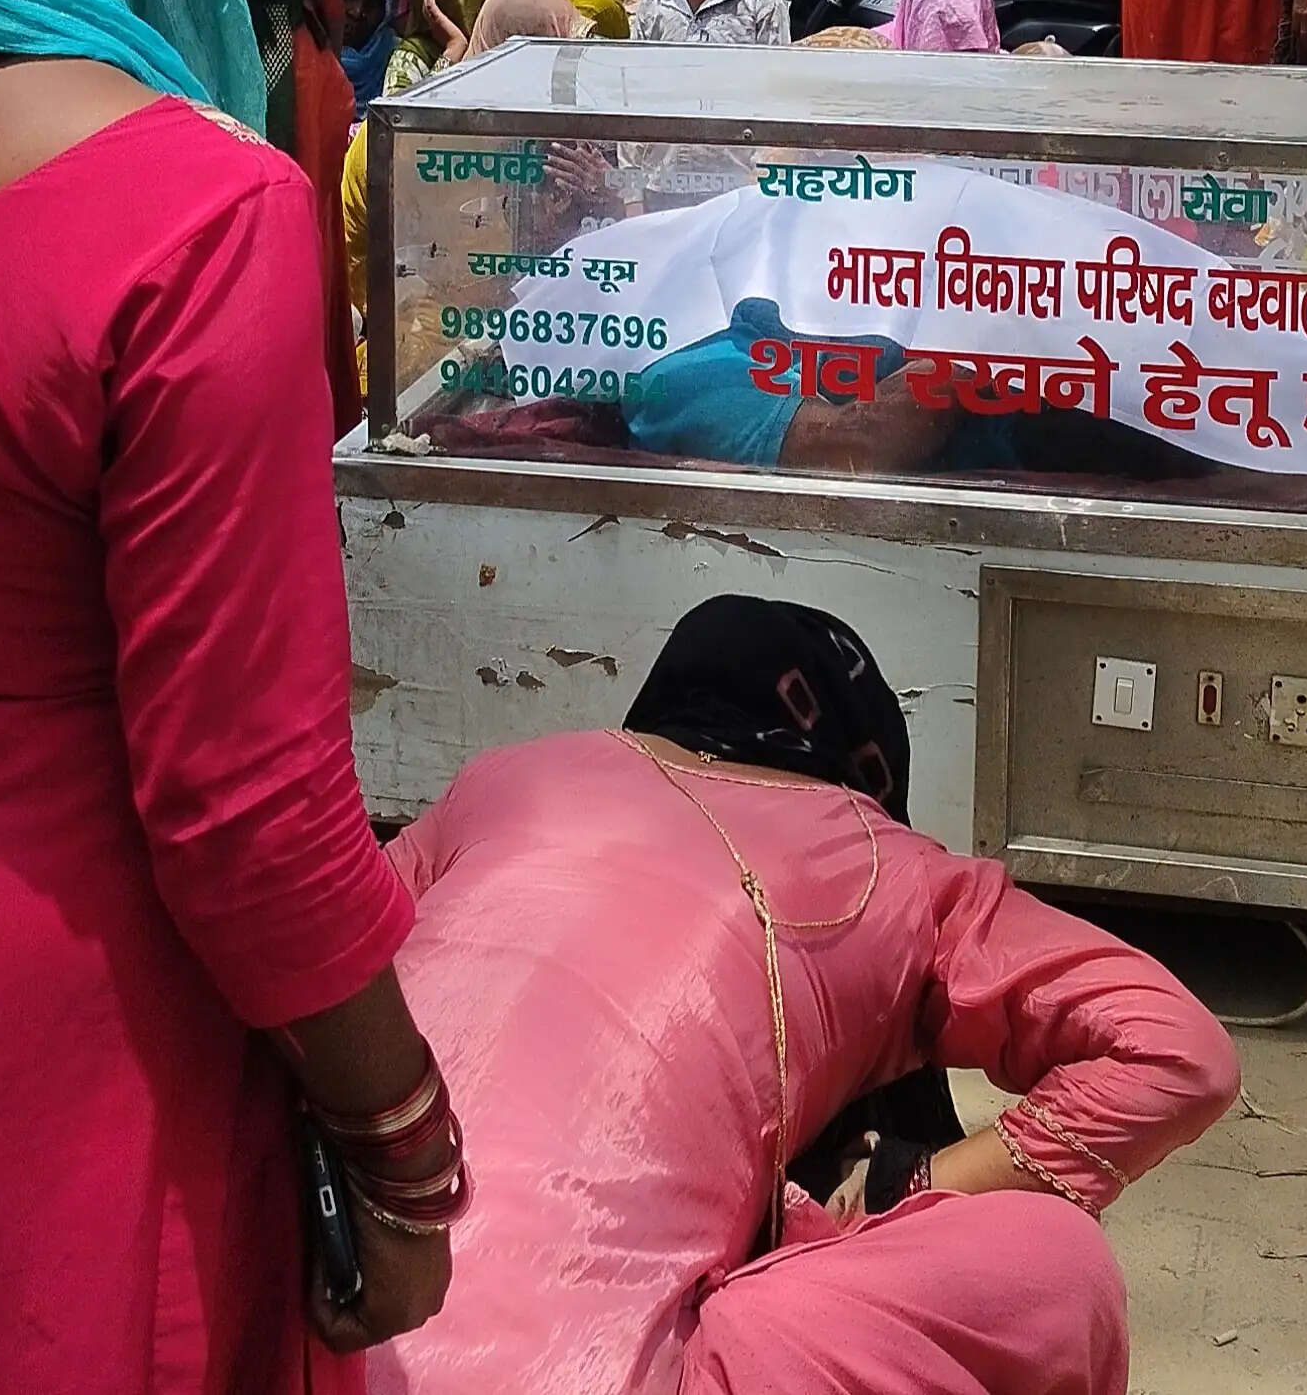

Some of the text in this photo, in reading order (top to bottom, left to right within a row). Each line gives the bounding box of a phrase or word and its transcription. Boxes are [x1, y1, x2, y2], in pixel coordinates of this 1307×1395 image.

[415, 139, 548, 183] सम्पर्क
[755, 154, 917, 203] सहयोग
[1180, 173, 1274, 224] सेवा
[467, 248, 638, 293] सम्पर्क सूत्र
[826, 246, 927, 308] भारत
[934, 226, 1066, 320] विकास
[1076, 236, 1198, 327] परिषद
[440, 306, 669, 352] 9896837696
[748, 336, 885, 403] शव
[903, 336, 1119, 420] रखने
[1140, 339, 1293, 449] हेतू
